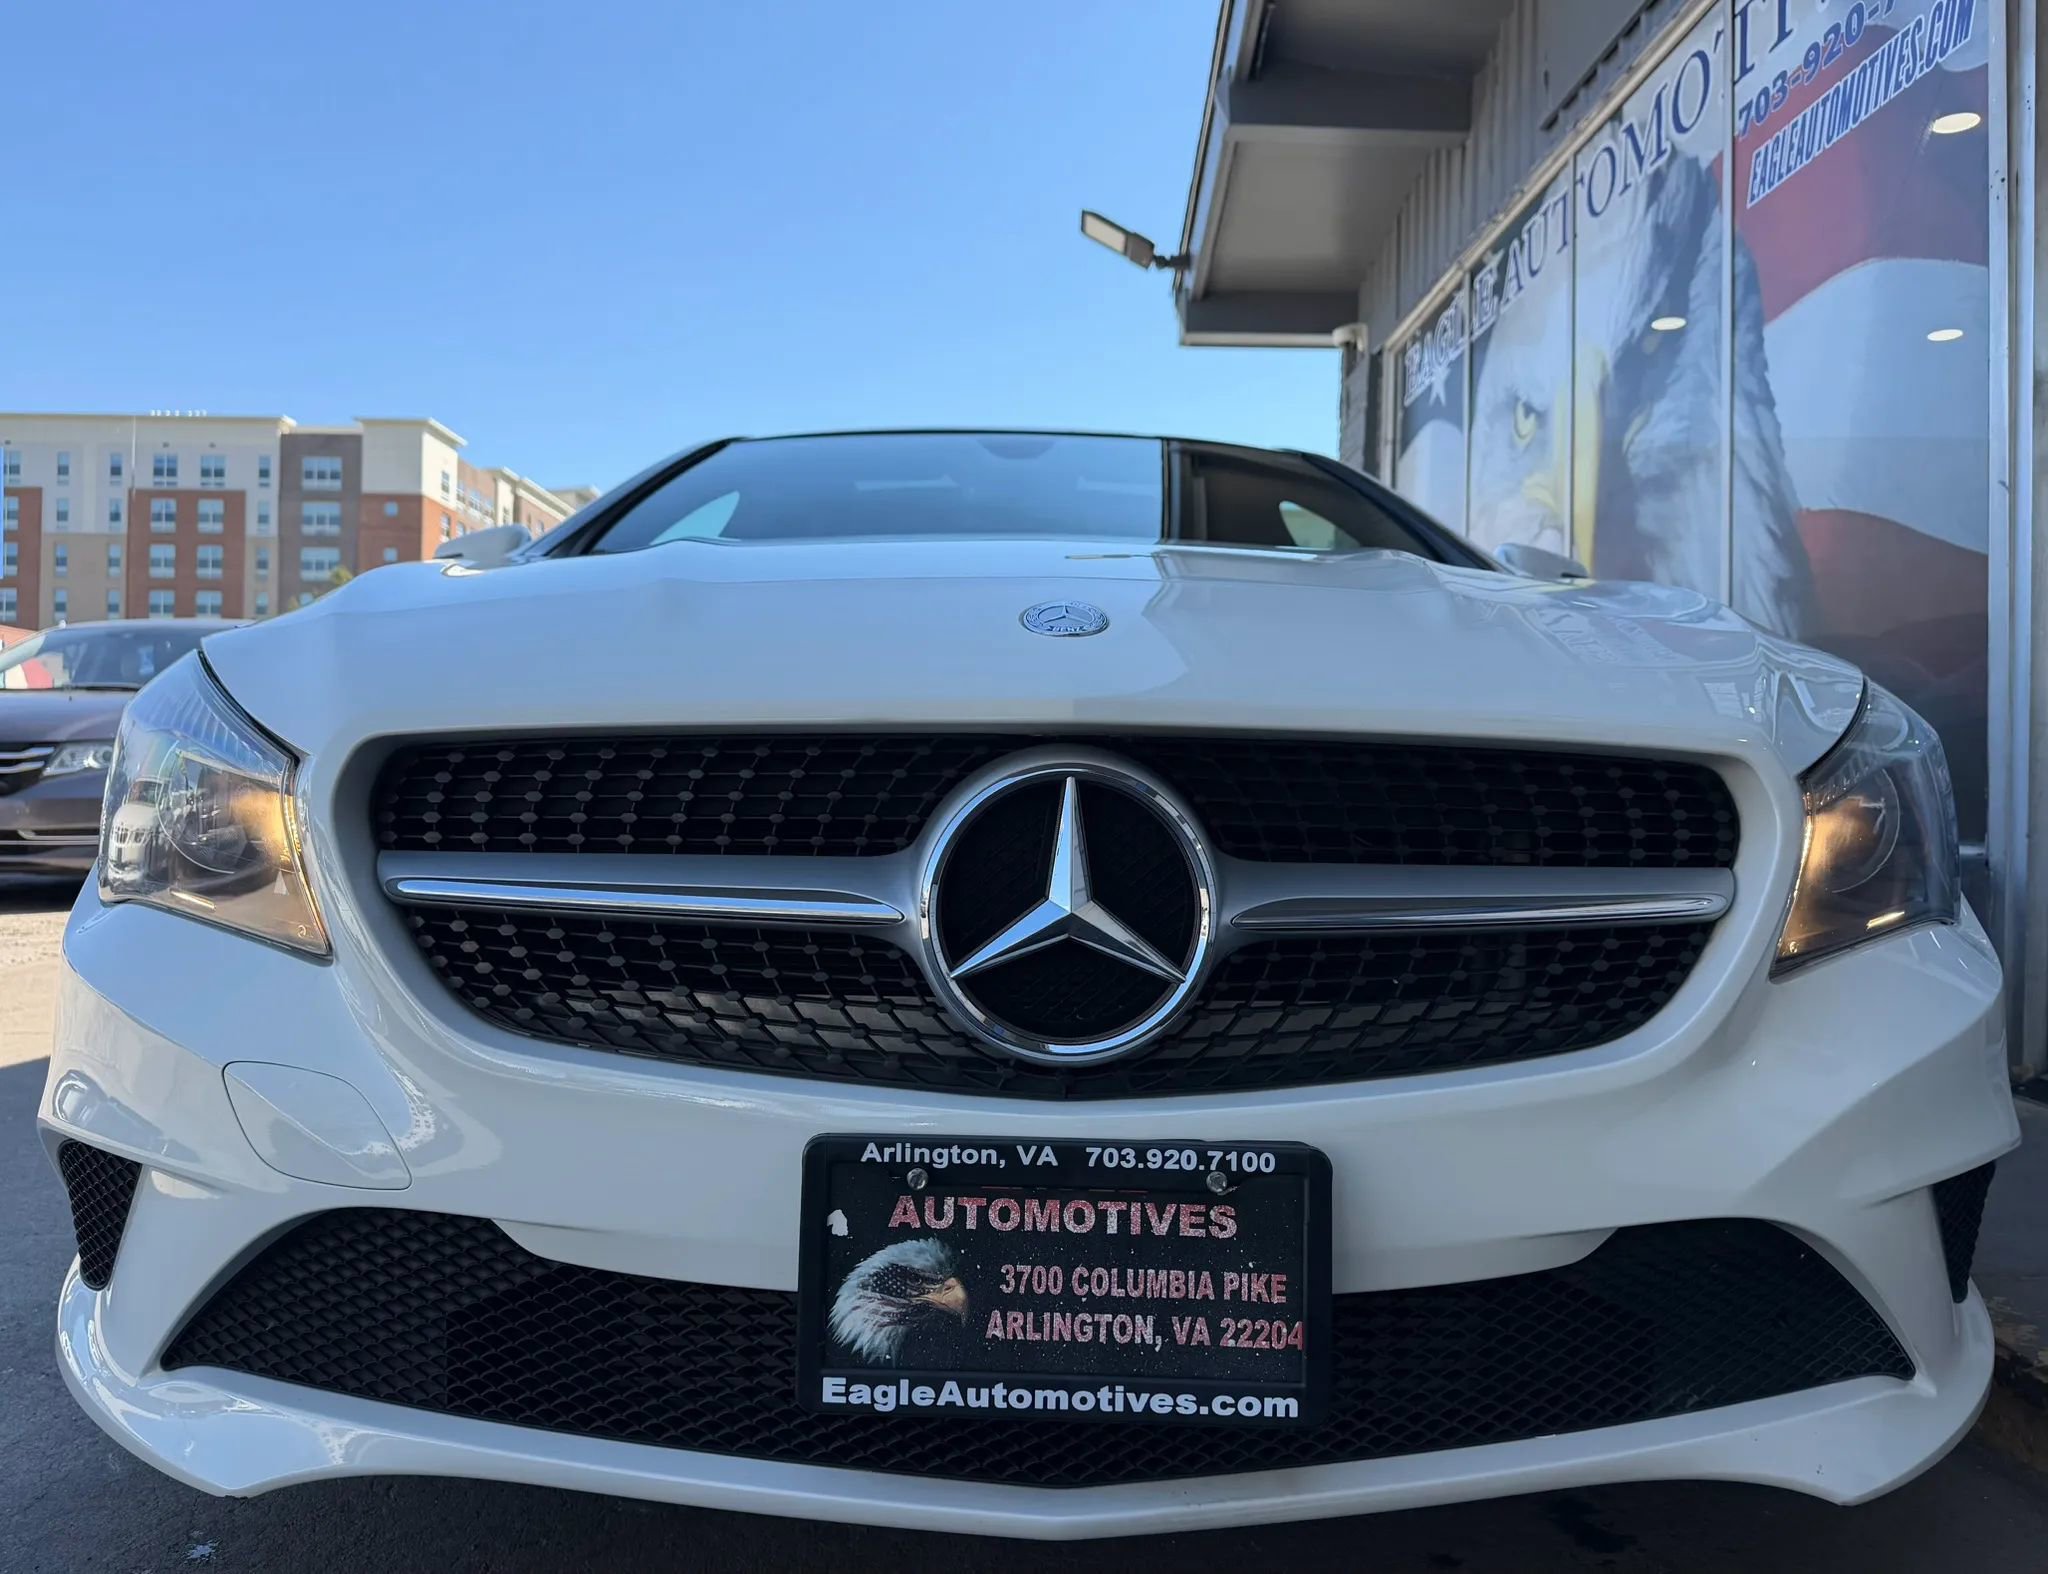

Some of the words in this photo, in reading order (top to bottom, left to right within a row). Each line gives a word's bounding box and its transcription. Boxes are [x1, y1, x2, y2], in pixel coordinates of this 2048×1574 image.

[1747, 0, 1976, 208] EAGLEAUTOMOTIVES.COM
[861, 1142, 1006, 1168] Arlington,
[1016, 1145, 1059, 1167] VA
[1086, 1146, 1276, 1173] 703.920.7100
[888, 1195, 1238, 1240] AUTOMOTIVES
[1000, 1264, 1063, 1295] 3700
[1071, 1266, 1215, 1300] COLUMBIA
[1223, 1271, 1287, 1304] PIKE
[985, 1310, 1163, 1352] ARLINGTON,
[1171, 1316, 1212, 1346] VA
[1219, 1317, 1304, 1351] 22204
[821, 1376, 1299, 1418] EagleAutomotives.com
